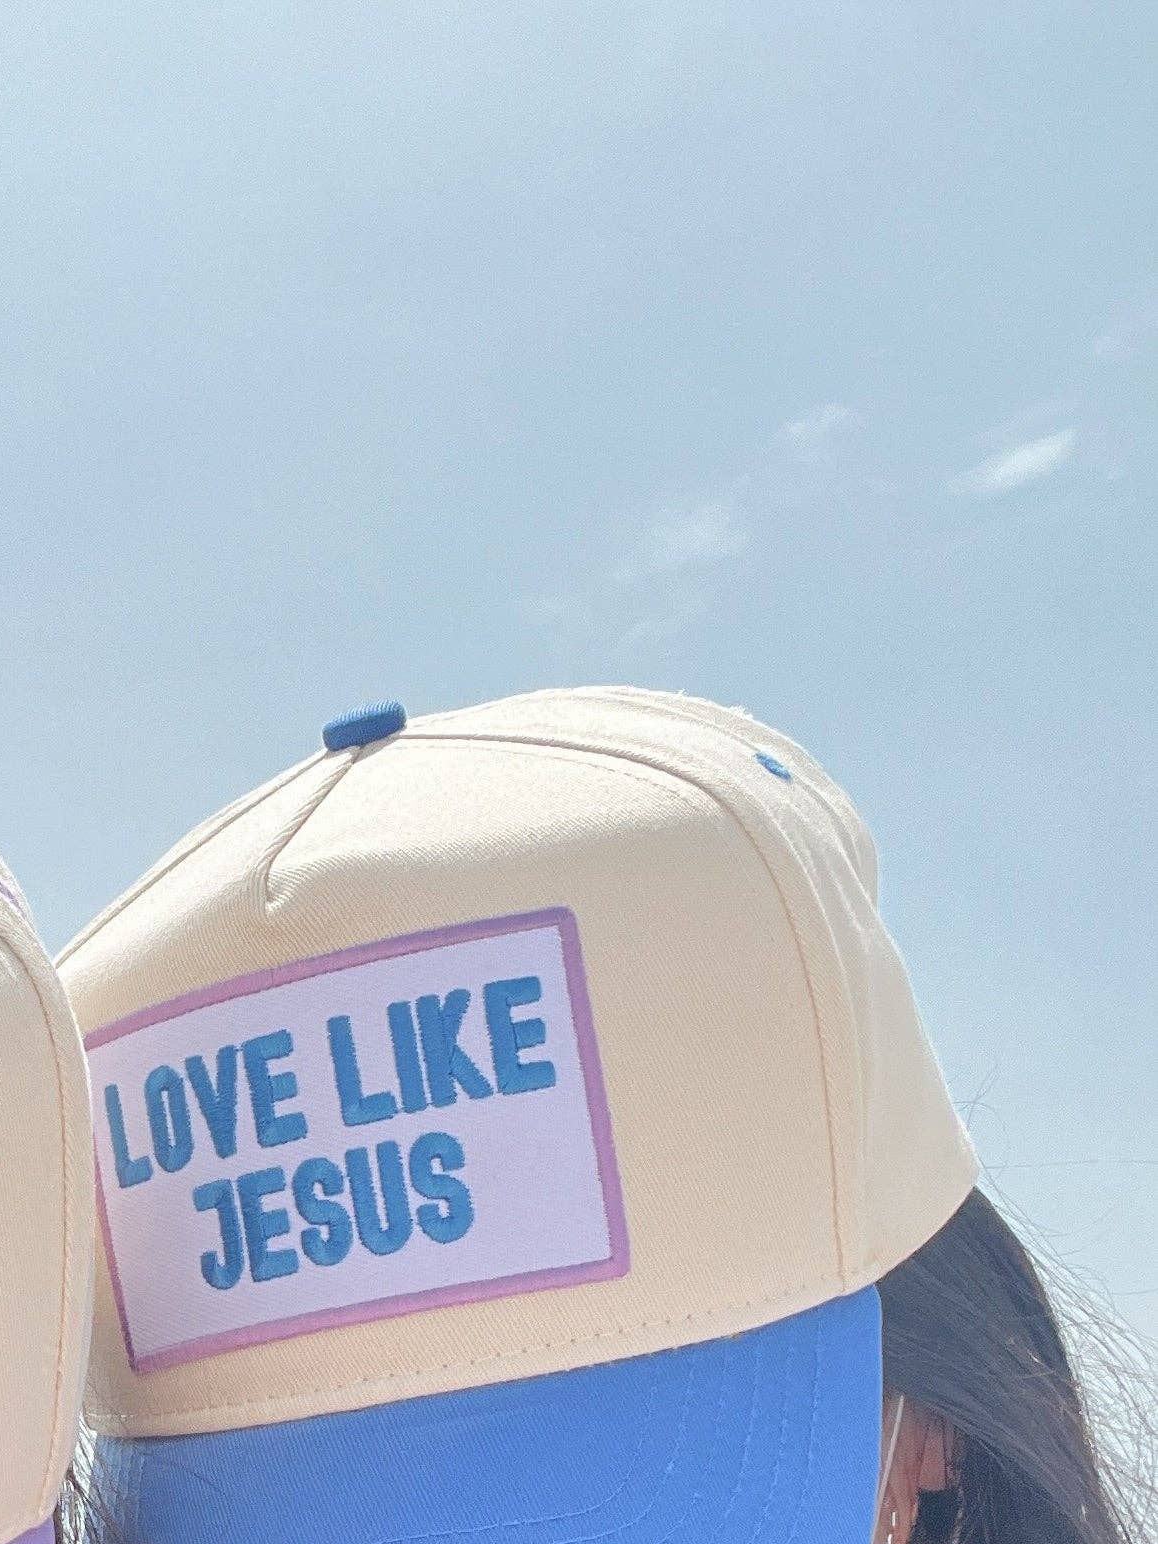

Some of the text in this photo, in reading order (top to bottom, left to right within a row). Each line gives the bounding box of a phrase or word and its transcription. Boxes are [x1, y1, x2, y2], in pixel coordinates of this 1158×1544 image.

[105, 976, 557, 1188] LOVE LIKE
[192, 1132, 475, 1290] JESUS
